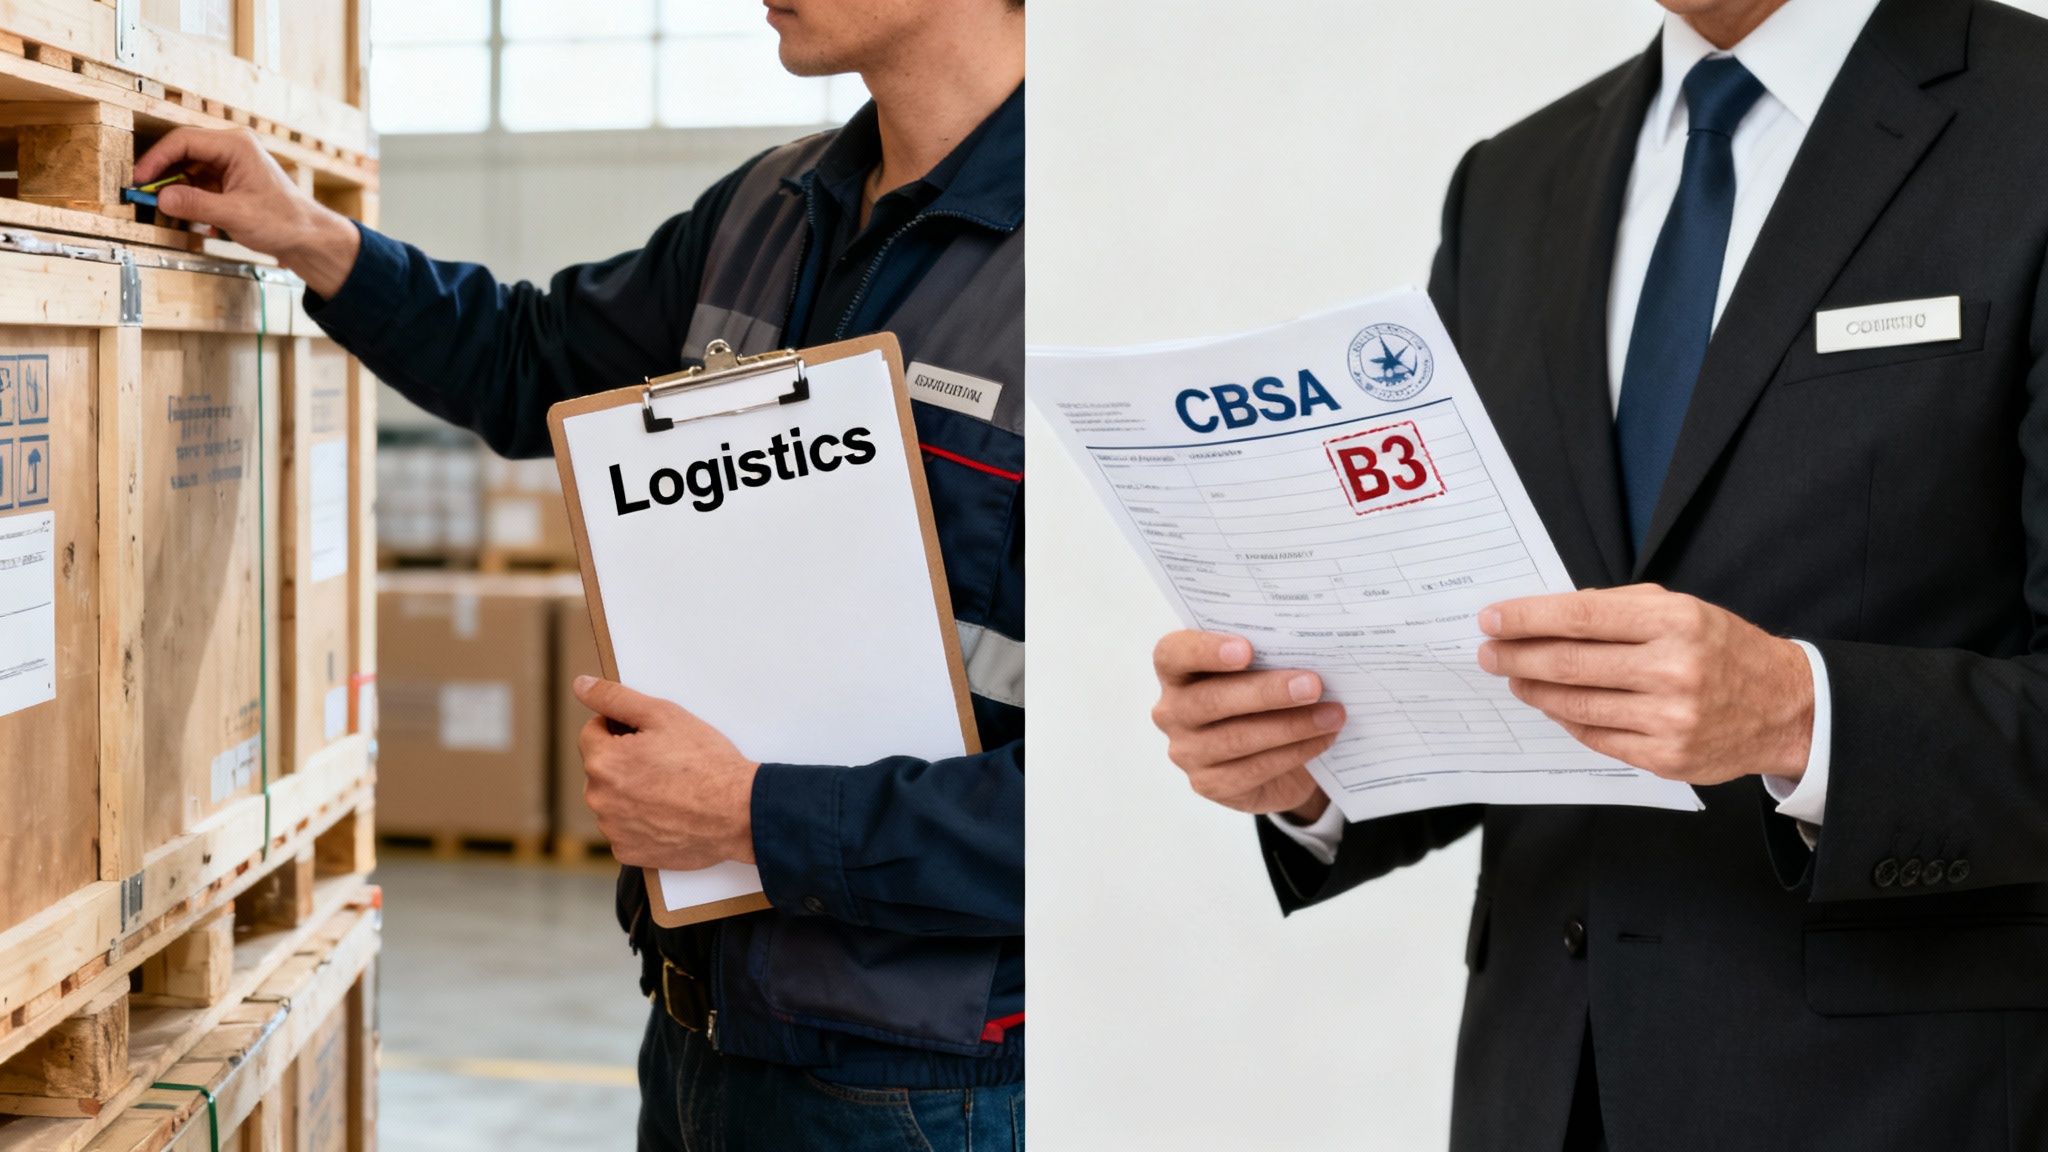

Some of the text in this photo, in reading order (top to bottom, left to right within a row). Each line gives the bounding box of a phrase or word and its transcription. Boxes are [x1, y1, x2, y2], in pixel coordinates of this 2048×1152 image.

[1175, 368, 1341, 433] CBSA
[608, 426, 877, 516] Logistics
[1338, 435, 1427, 502] B3
